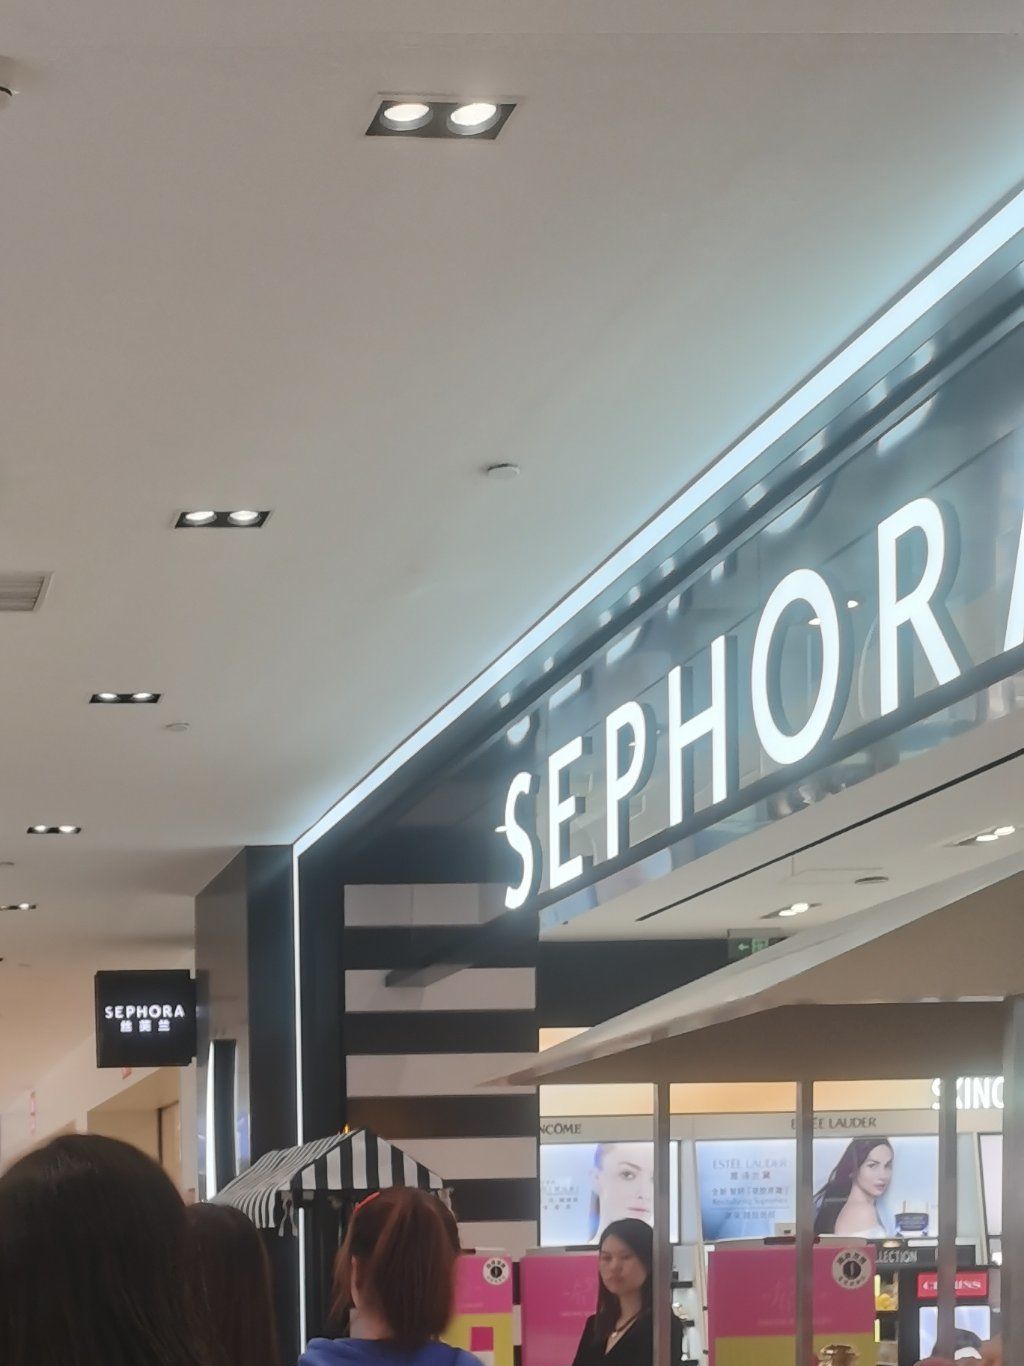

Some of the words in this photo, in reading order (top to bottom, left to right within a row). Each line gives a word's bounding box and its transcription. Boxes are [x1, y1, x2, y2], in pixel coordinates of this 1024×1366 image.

[504, 497, 1024, 909] SEPHOR
[104, 1004, 185, 1019] SEPHORA
[828, 1116, 877, 1130] LAUDER
[875, 1249, 918, 1264] LECTION
